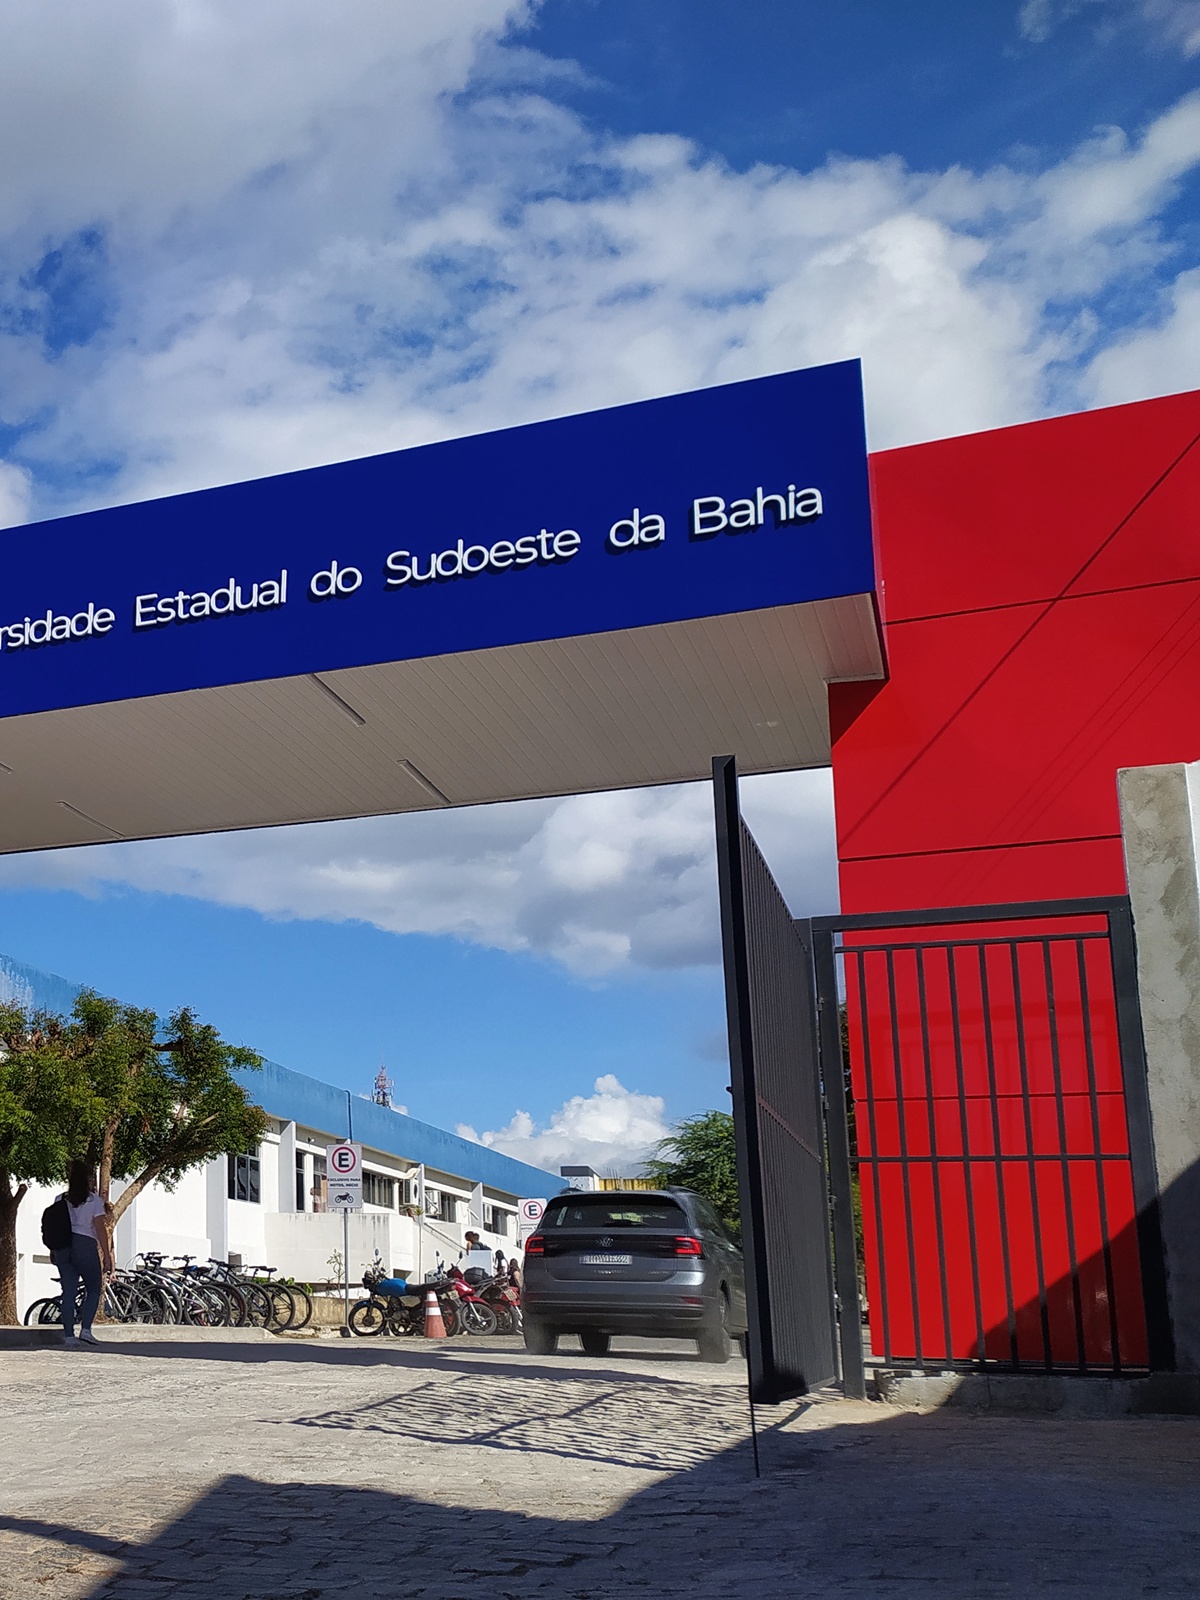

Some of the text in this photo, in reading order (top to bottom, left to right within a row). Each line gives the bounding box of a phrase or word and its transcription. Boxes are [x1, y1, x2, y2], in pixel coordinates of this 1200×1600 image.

[136, 570, 288, 626] Estadual
[310, 560, 363, 596] do
[386, 528, 581, 585] Sudoeste
[609, 508, 665, 547] da
[693, 484, 823, 535] Bahia
[338, 1152, 350, 1168] E
[528, 1204, 538, 1216] E
